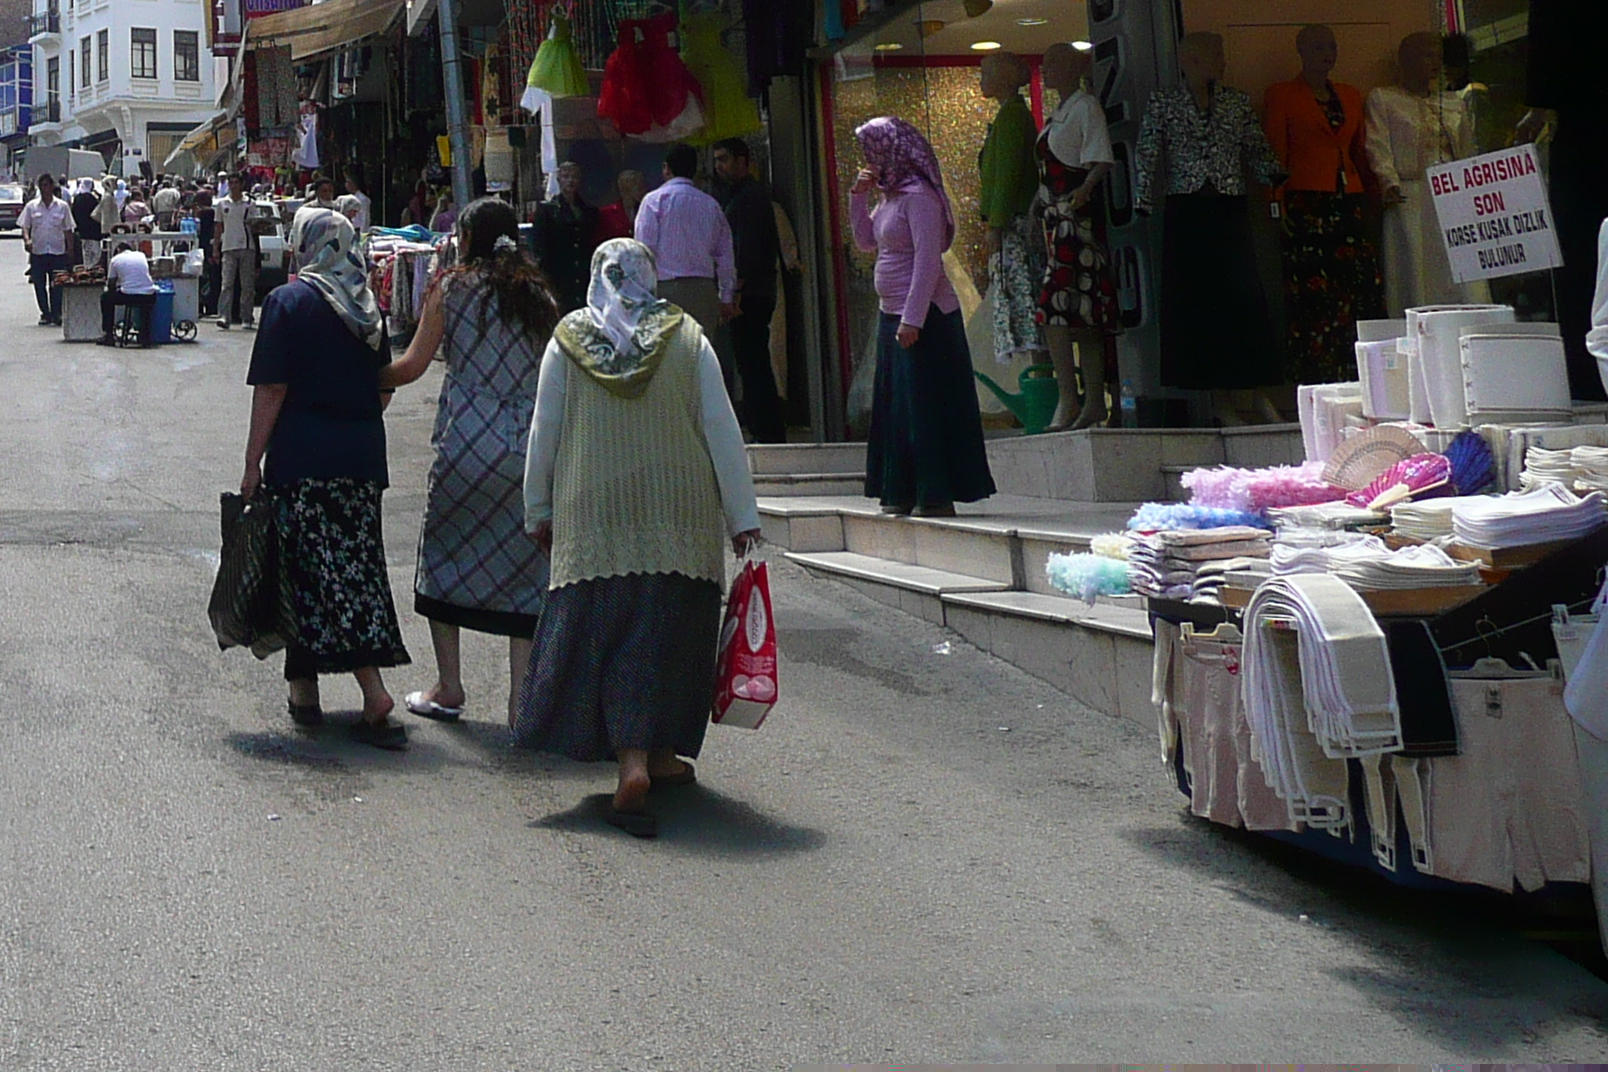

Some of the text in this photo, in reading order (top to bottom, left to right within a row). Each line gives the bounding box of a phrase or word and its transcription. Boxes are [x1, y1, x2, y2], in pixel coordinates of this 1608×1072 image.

[1431, 172, 1460, 196] BEL
[1474, 190, 1505, 216] SON
[1445, 224, 1477, 247] KORSE
[1477, 242, 1527, 269] BULUNUR
